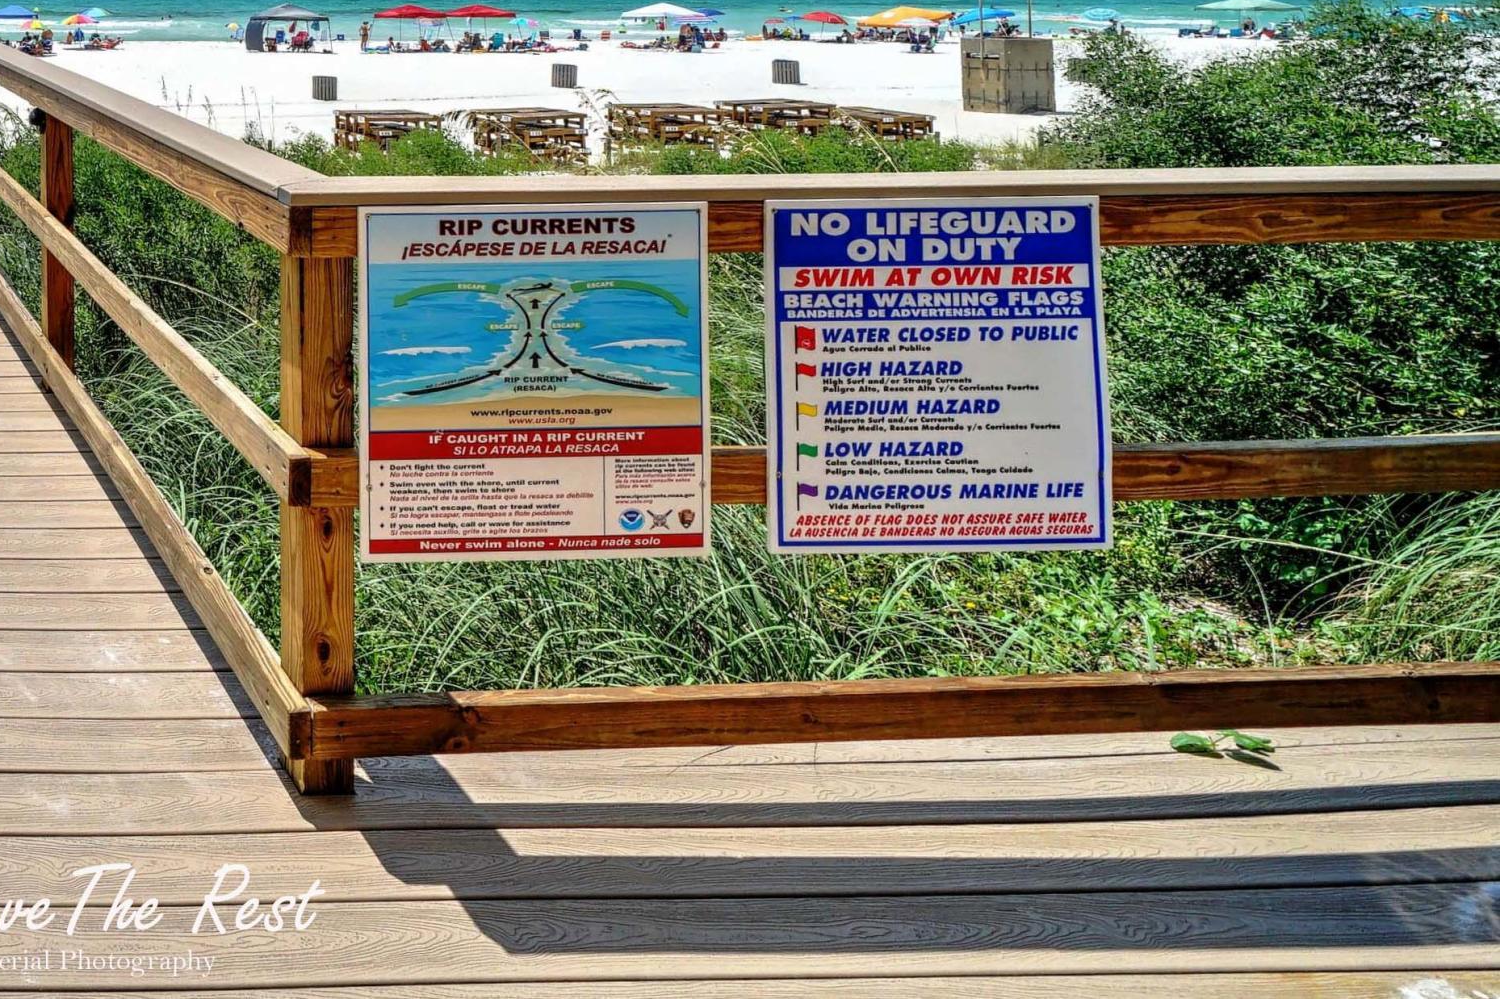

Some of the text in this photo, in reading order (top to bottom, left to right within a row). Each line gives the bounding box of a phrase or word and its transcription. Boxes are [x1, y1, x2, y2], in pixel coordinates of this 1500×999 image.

[439, 217, 634, 235] RIP CURRENTS
[790, 210, 1075, 236] NO LIFEGUARD
[401, 239, 666, 259] ¡ESCÁPESE DE LA RESACA!
[846, 237, 1021, 262] ON DUTY
[794, 266, 1073, 287] SWIM AT OWN RISK
[457, 283, 486, 291] ESCAPE
[586, 280, 614, 288] ESCAPE
[783, 290, 1083, 311] BEACH WARNING FLAGS
[787, 306, 1081, 318] BANDERAS DE ADVERTENSIA EN LA PLAYA
[822, 325, 1077, 342] WATER CLOSED TO PUBLIC
[822, 345, 845, 354] Agua
[820, 361, 962, 377] HIGH HAZARD
[522, 375, 568, 383] CURRENT
[822, 377, 843, 386] High
[867, 377, 899, 386] and/or
[903, 377, 931, 386] Strong
[935, 376, 971, 384] Currents
[513, 384, 556, 392] (RESACA)
[470, 407, 612, 418] www.ripcurrents.noaa.gov
[824, 399, 999, 415] MEDIUM HAZARD
[887, 416, 917, 425] and/or
[429, 432, 644, 444] IF CAUGHT IN A RIP CURRENT
[453, 444, 618, 455] SI LO ATRAPA LA RESACA
[824, 441, 963, 457] LOW HAZARD
[414, 463, 433, 472] fight
[825, 482, 1083, 499] DANGEROUS MARINE LIFE
[884, 502, 924, 511] Peligrosa
[796, 512, 1086, 525] ABSENCE OF FLAG DOES NOT ASSURE SAFE WATER
[789, 524, 1093, 537] LA AUSENCIA DE BANDERAS NO ASEGURA AGUAS SEGURAS
[419, 536, 660, 549] Never swim alone Nunca nade solo
